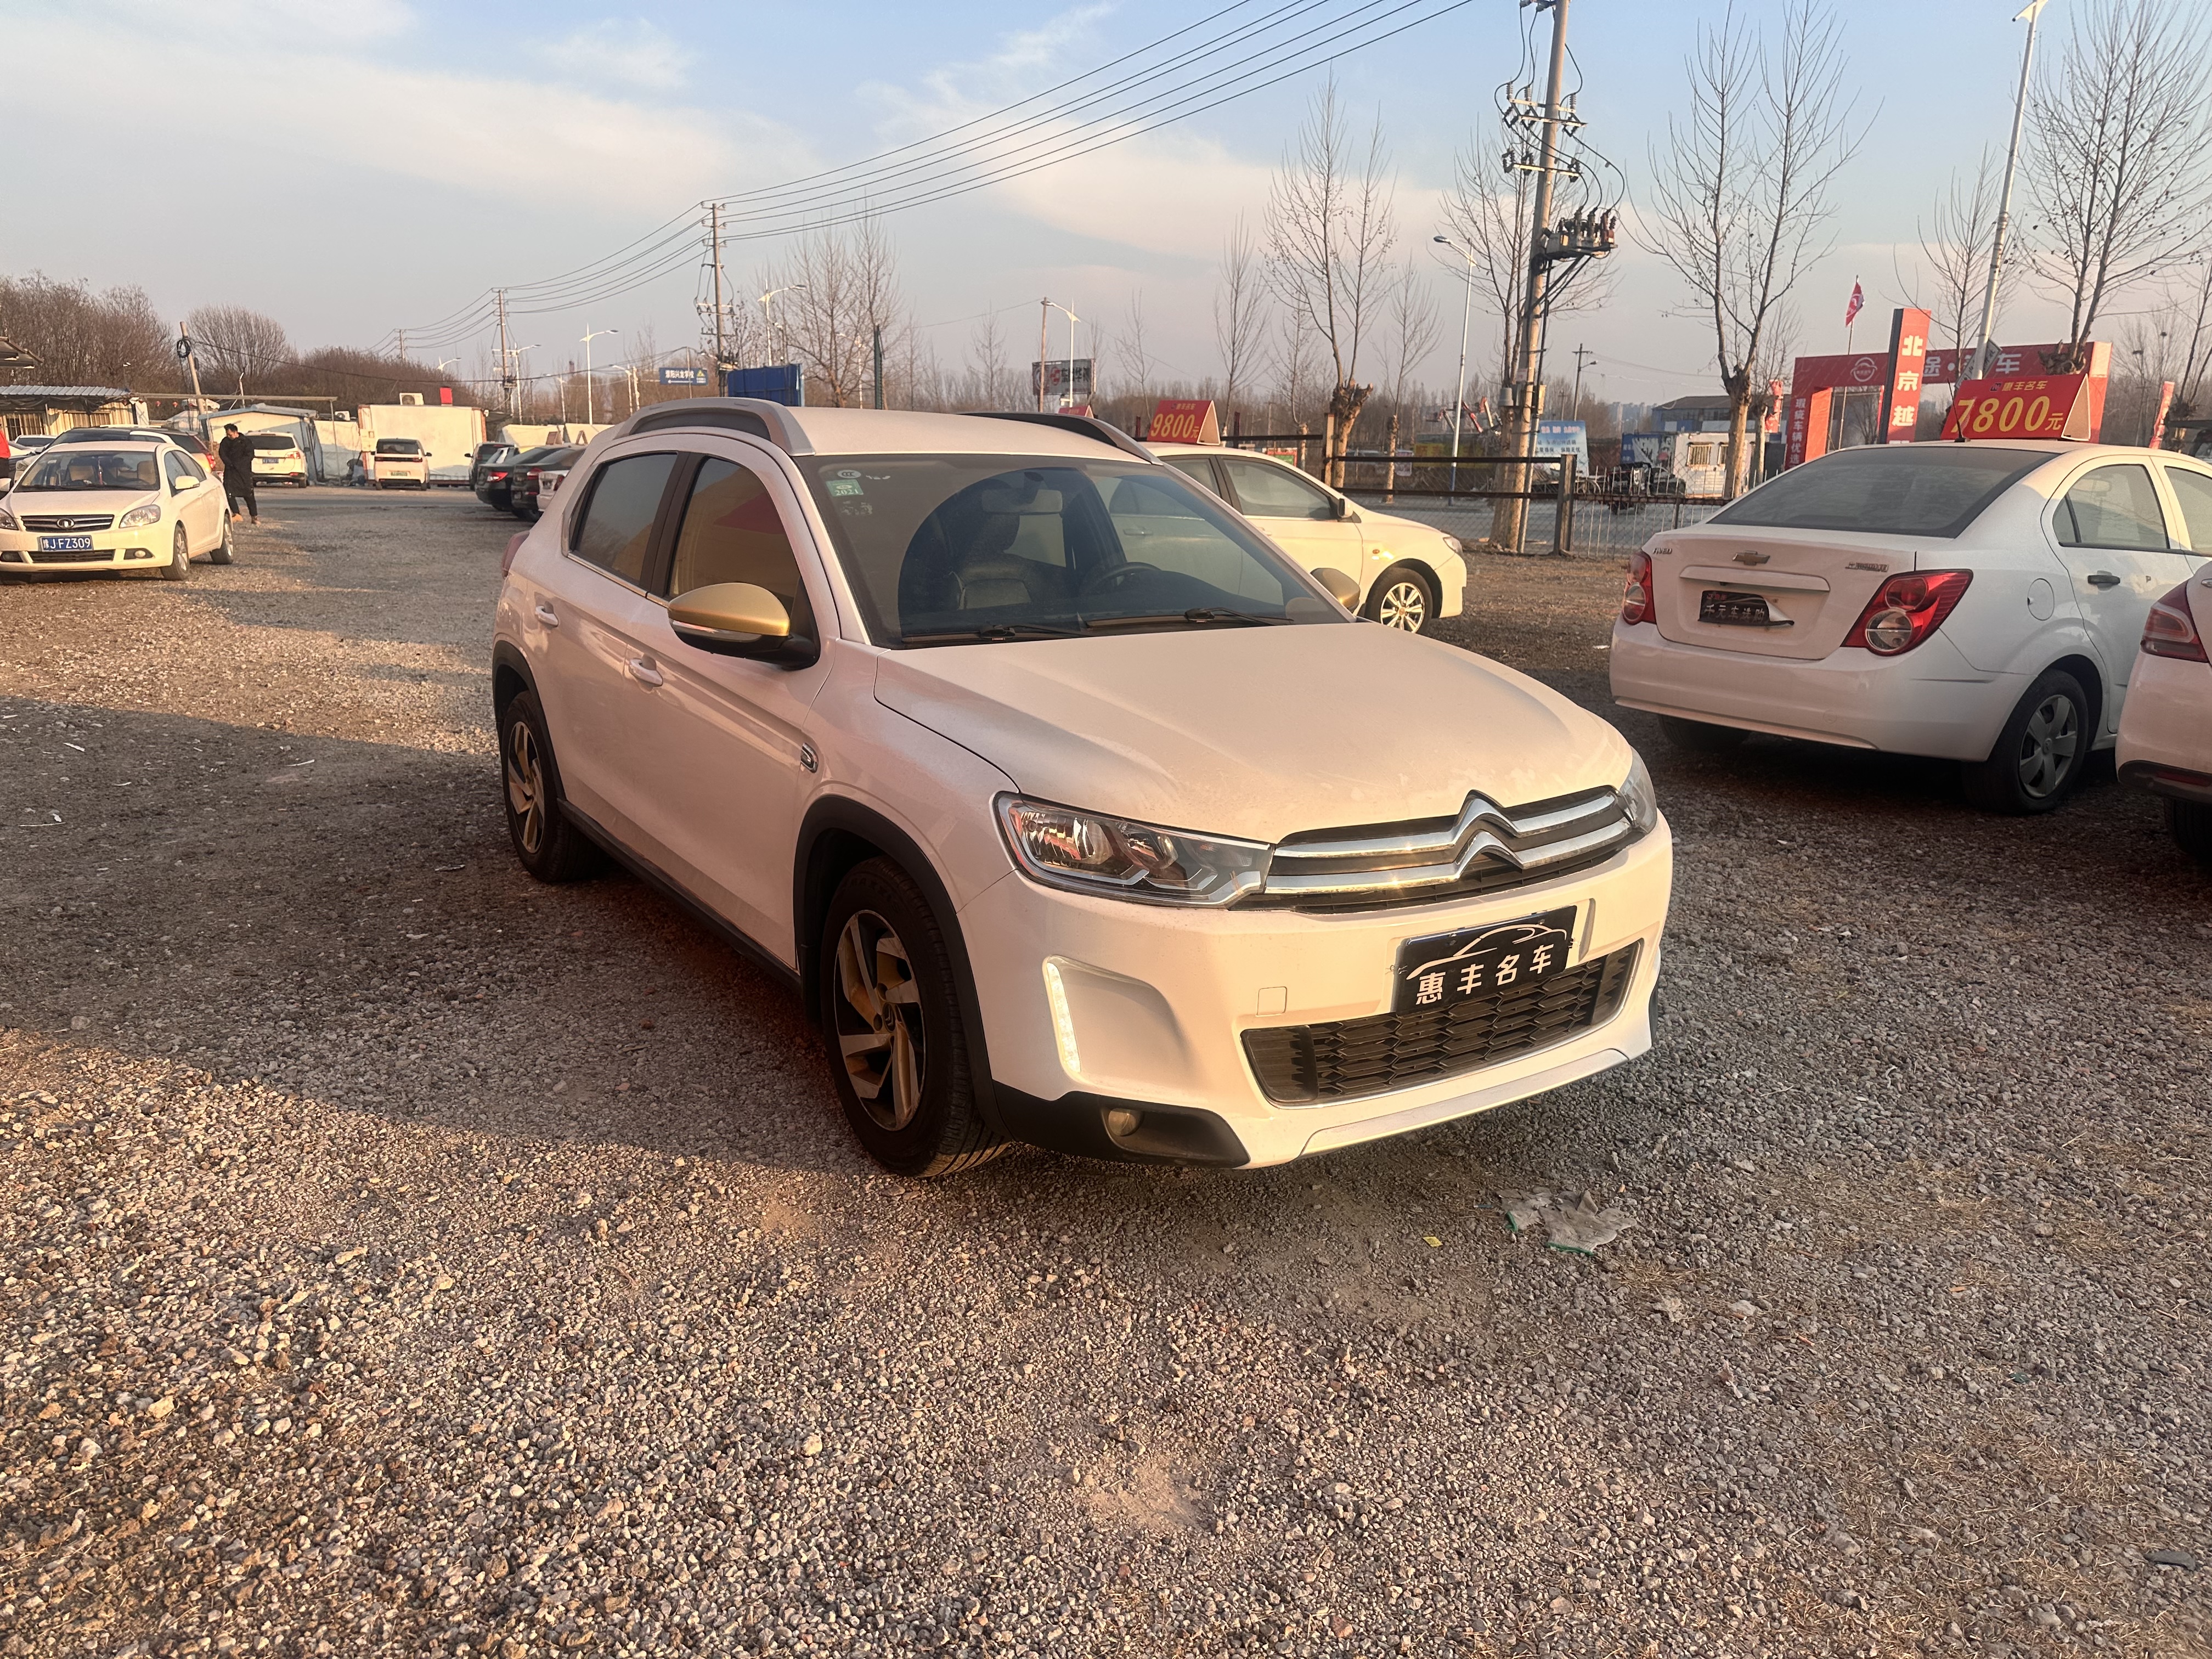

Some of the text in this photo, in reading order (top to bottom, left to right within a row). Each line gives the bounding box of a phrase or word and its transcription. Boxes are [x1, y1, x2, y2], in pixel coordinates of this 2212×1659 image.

[1889, 335, 1923, 444] 北京越
[1415, 944, 1554, 1005] 惠丰名车
